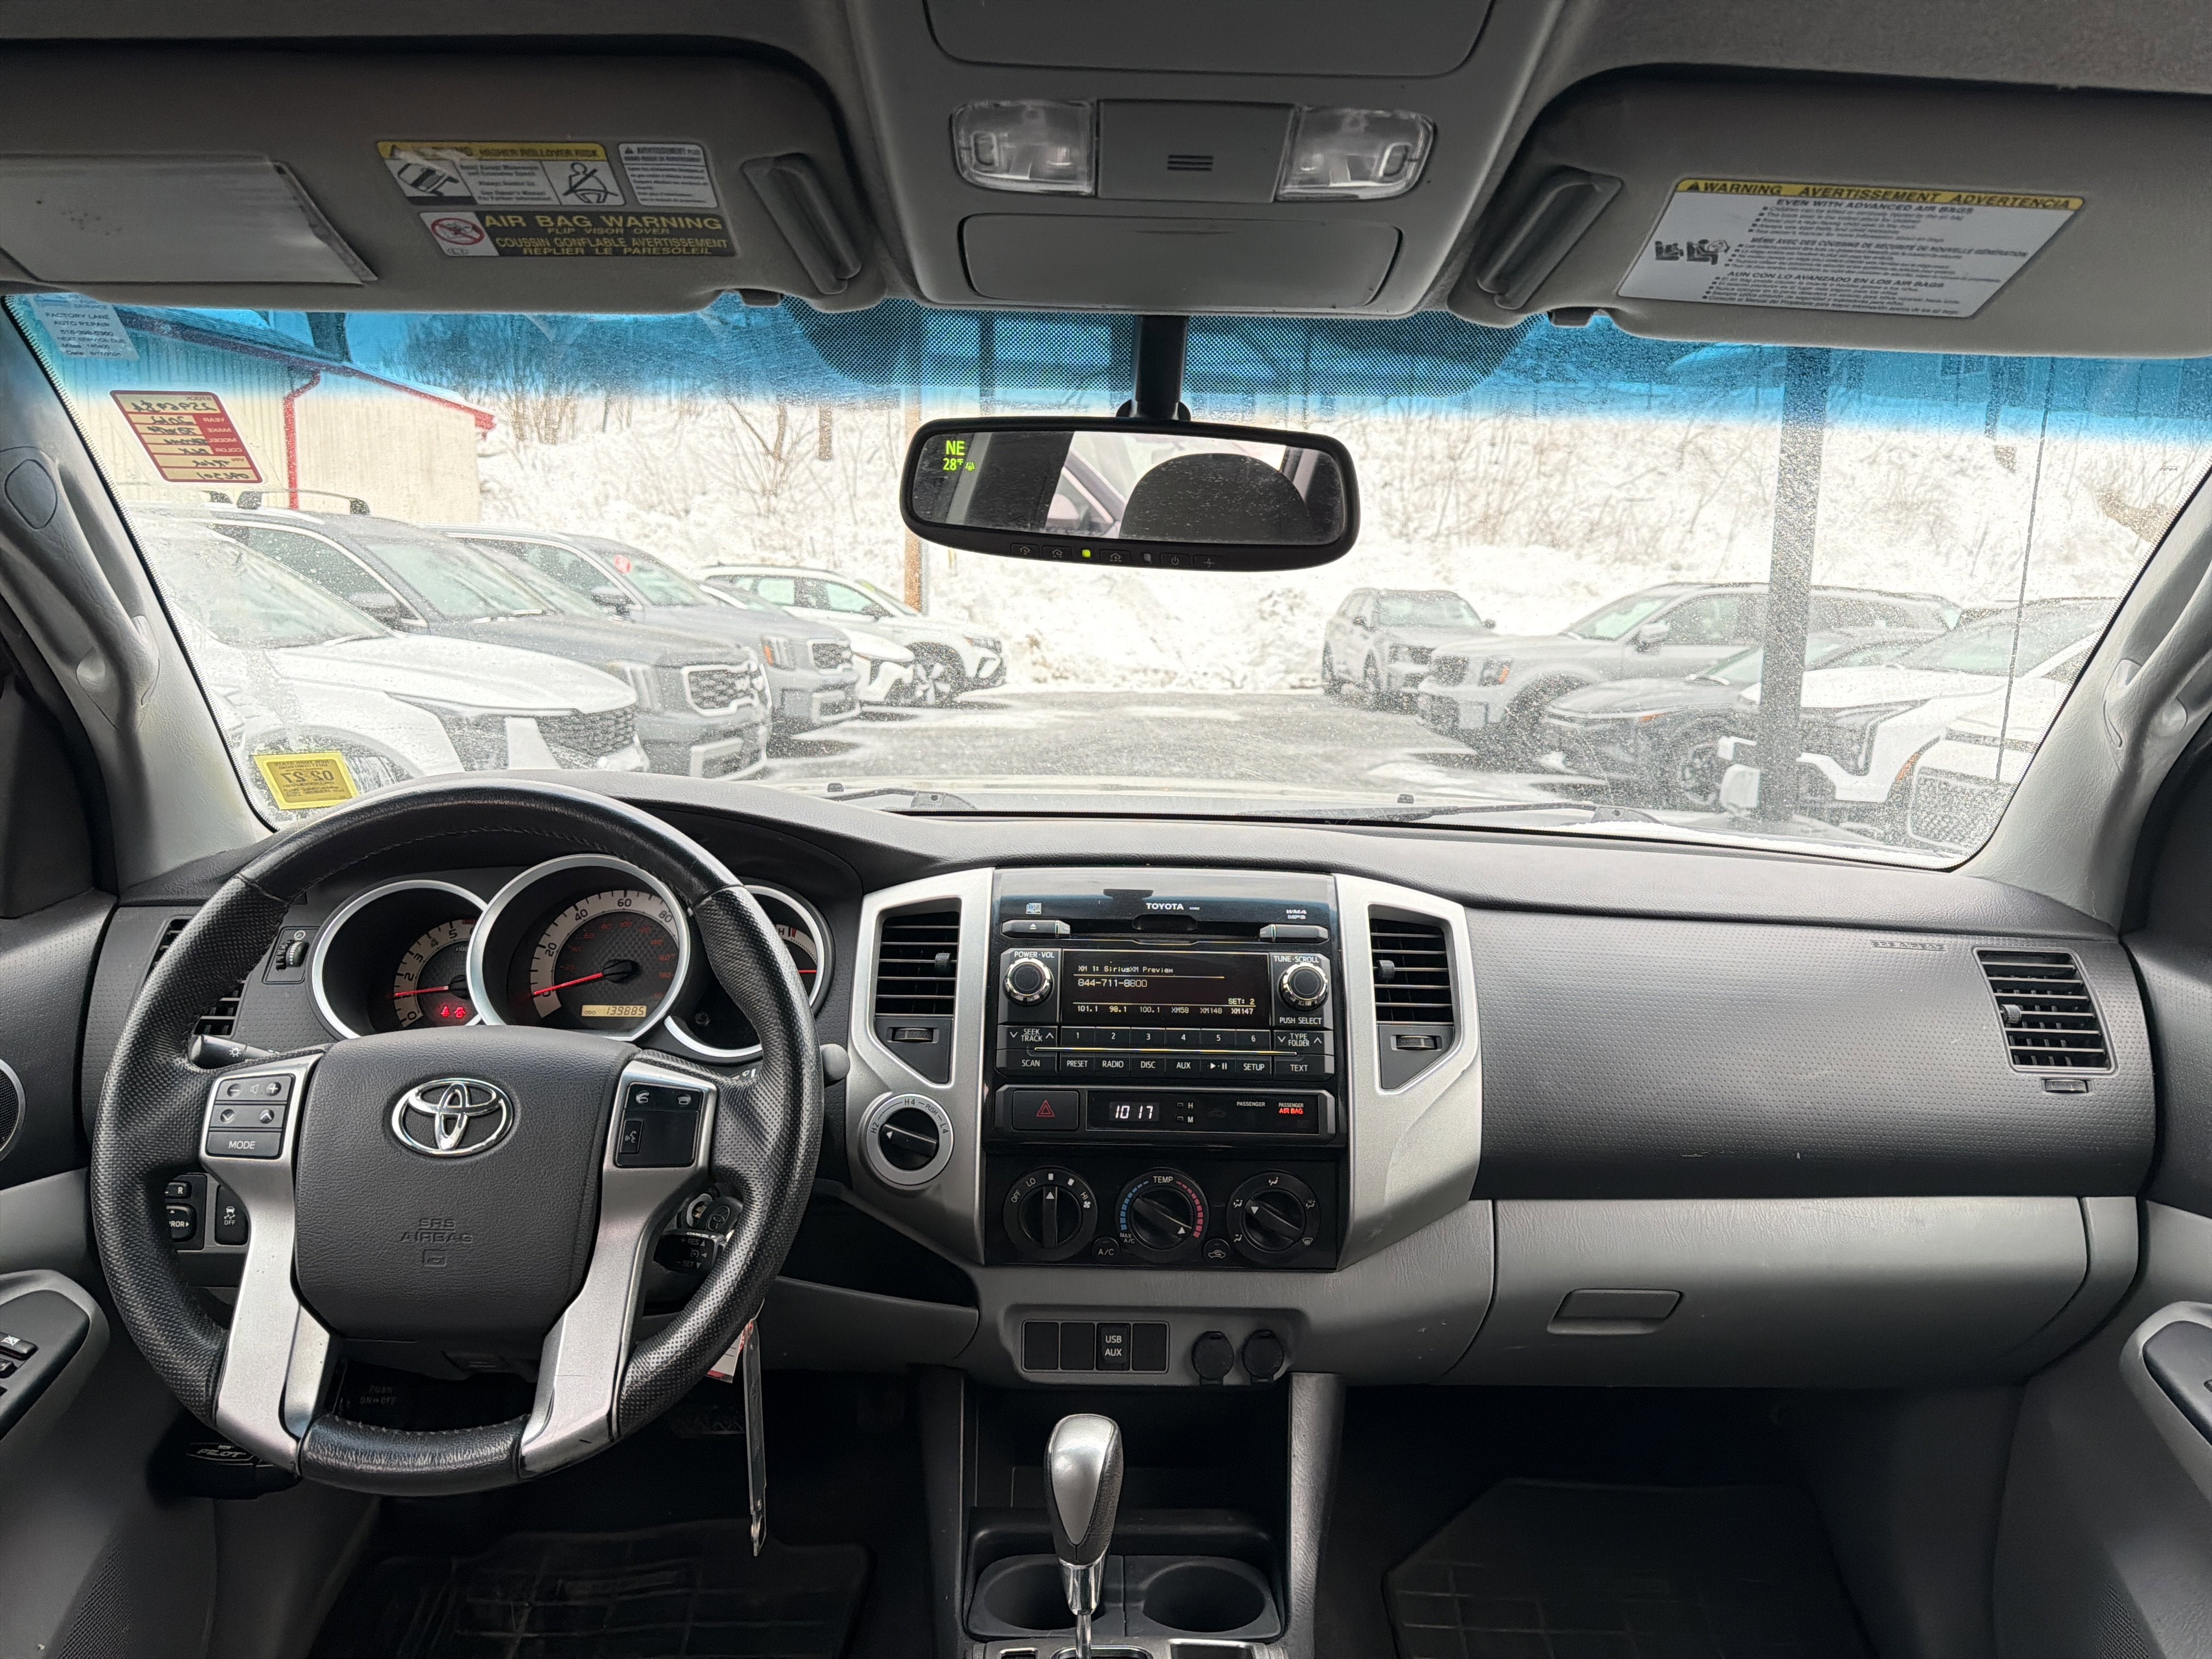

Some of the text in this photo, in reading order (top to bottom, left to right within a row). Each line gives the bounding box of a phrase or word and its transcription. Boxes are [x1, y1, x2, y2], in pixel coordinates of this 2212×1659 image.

[1703, 182, 2070, 210] WARNING AVERTISSEMENT ADVERTENCIA
[1846, 201, 1912, 211] ADVANCED
[485, 215, 723, 230] AIR BAG WARNING
[496, 238, 727, 249] COUSSIN GONFLABLE AVERTISSEMENT
[623, 247, 713, 256] PARESOLEIL
[1794, 274, 1851, 283] AVANZADO
[945, 440, 965, 456] NE
[617, 898, 632, 907] 60
[1146, 902, 1184, 911] TOYOTA
[575, 909, 588, 922] 40
[658, 910, 673, 923] 80
[449, 928, 458, 939] 5
[431, 938, 439, 948] 4
[545, 942, 557, 957] 20
[414, 952, 425, 963] 3
[403, 972, 415, 981] 2
[1077, 978, 1148, 988] 844-711-8800
[606, 1007, 644, 1015] 139885
[1111, 1032, 1116, 1040] 2
[925, 1103, 938, 1116] PUSH
[870, 1122, 879, 1134] H2
[940, 1122, 949, 1134] L4
[228, 1141, 256, 1150] MODE
[1025, 1177, 1036, 1187] LO
[1011, 1188, 1022, 1203] OFF
[1079, 1191, 1089, 1200] HI
[419, 1218, 456, 1229] SRS
[400, 1231, 474, 1244] AIRBAG
[1105, 1335, 1122, 1344] USB
[1104, 1348, 1122, 1357] AUX
